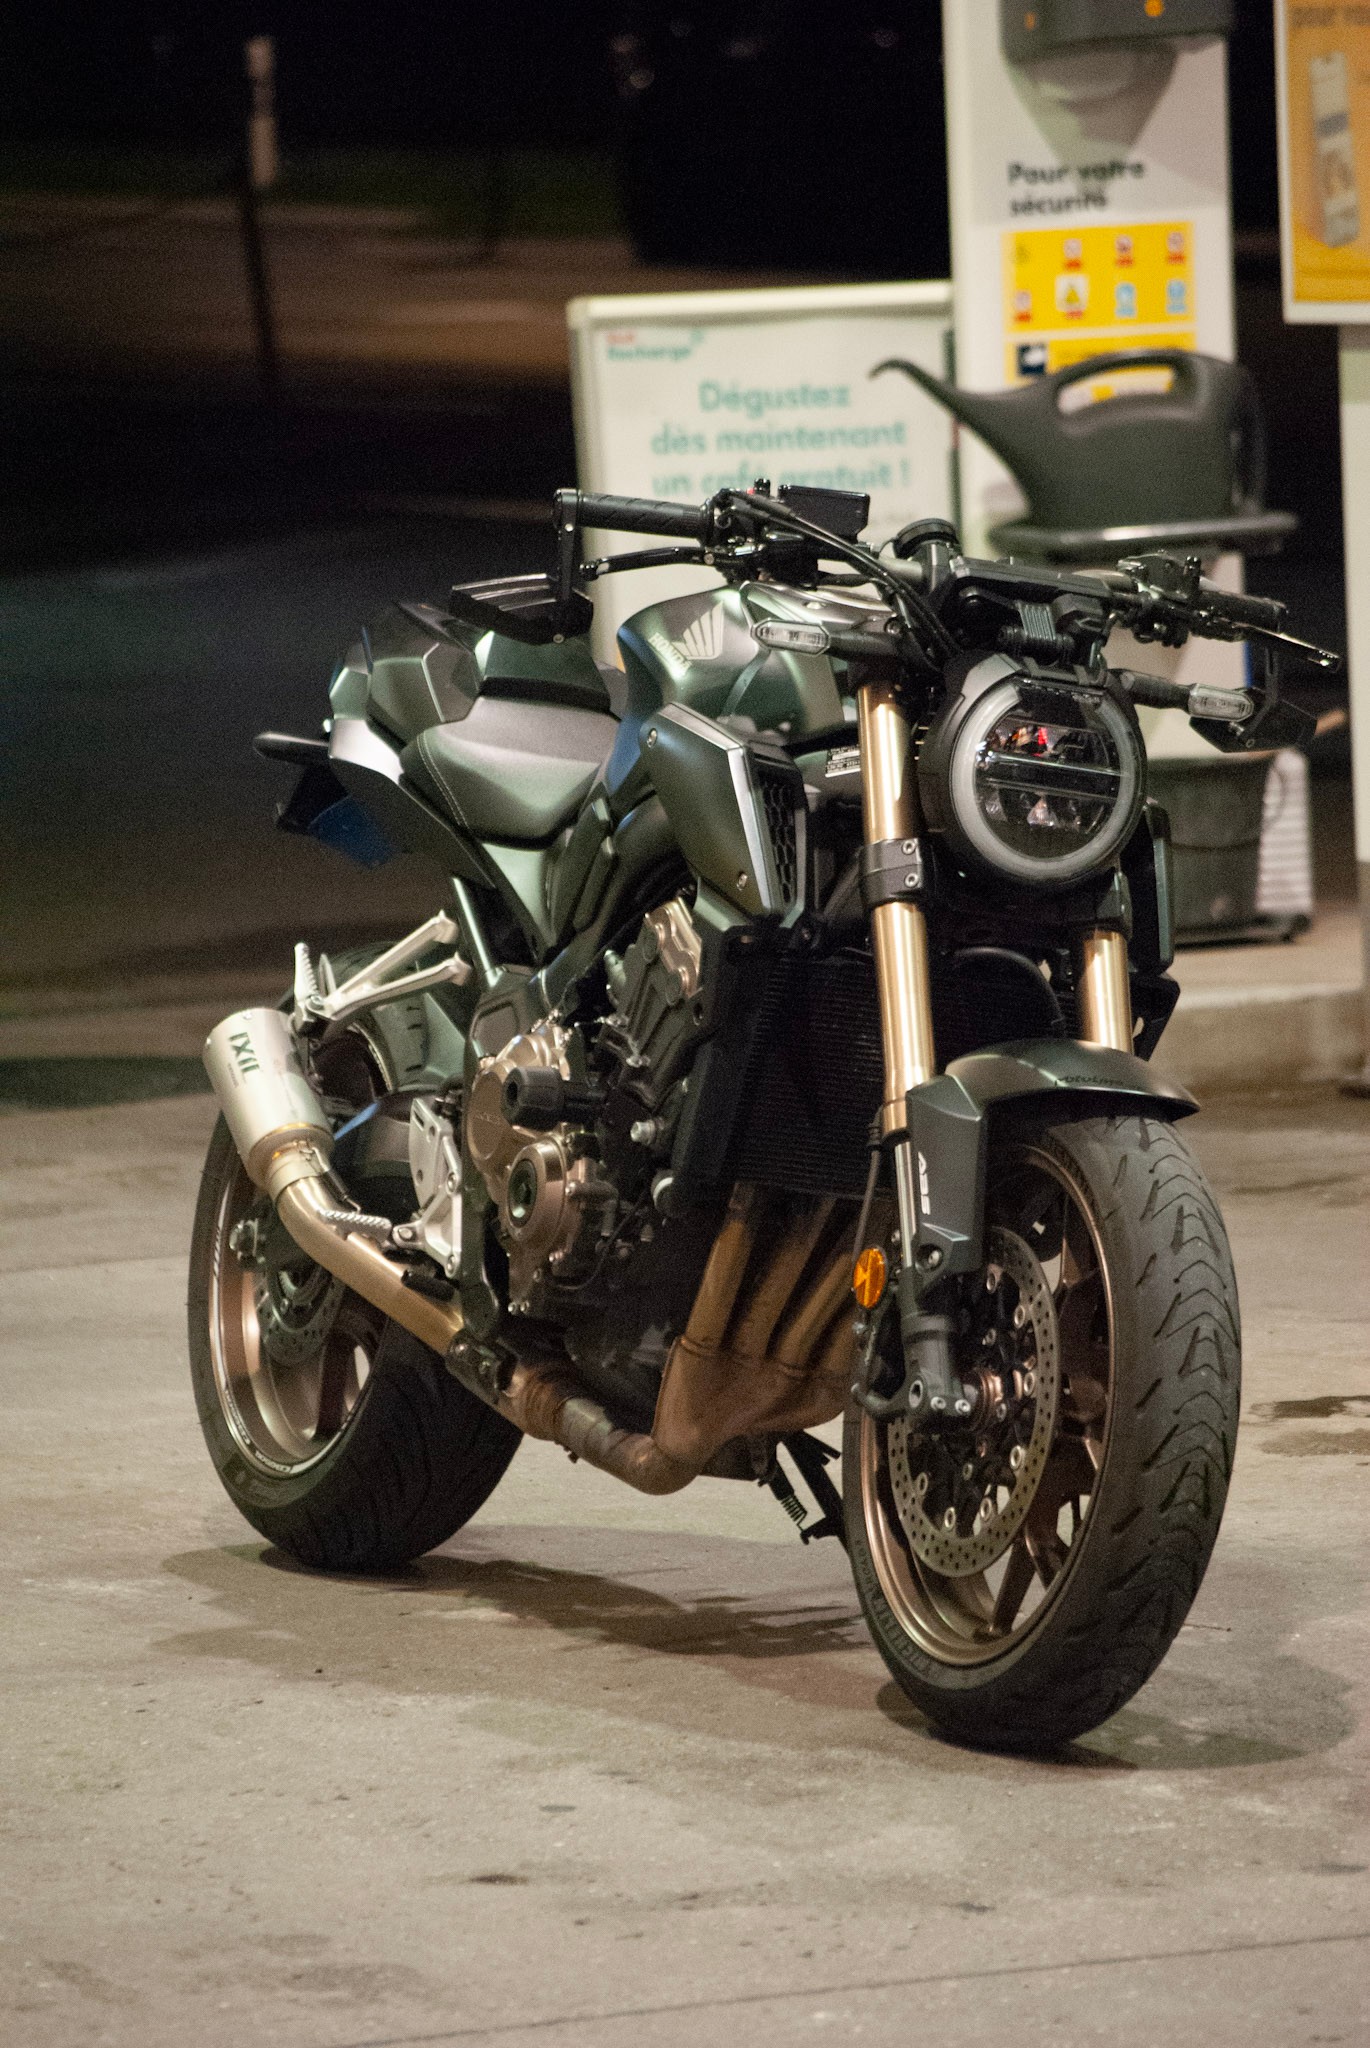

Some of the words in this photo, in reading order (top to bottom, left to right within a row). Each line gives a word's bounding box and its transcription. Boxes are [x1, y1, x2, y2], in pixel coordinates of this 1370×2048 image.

[1008, 161, 1068, 184] Pour
[1077, 158, 1145, 181] votre
[1009, 187, 1107, 215] sécurité
[698, 379, 852, 419] Dégustez
[651, 421, 707, 455] dès
[716, 420, 908, 454] maintenant
[653, 471, 692, 496] un
[648, 632, 692, 680] HONDA
[918, 1151, 932, 1216] ABS
